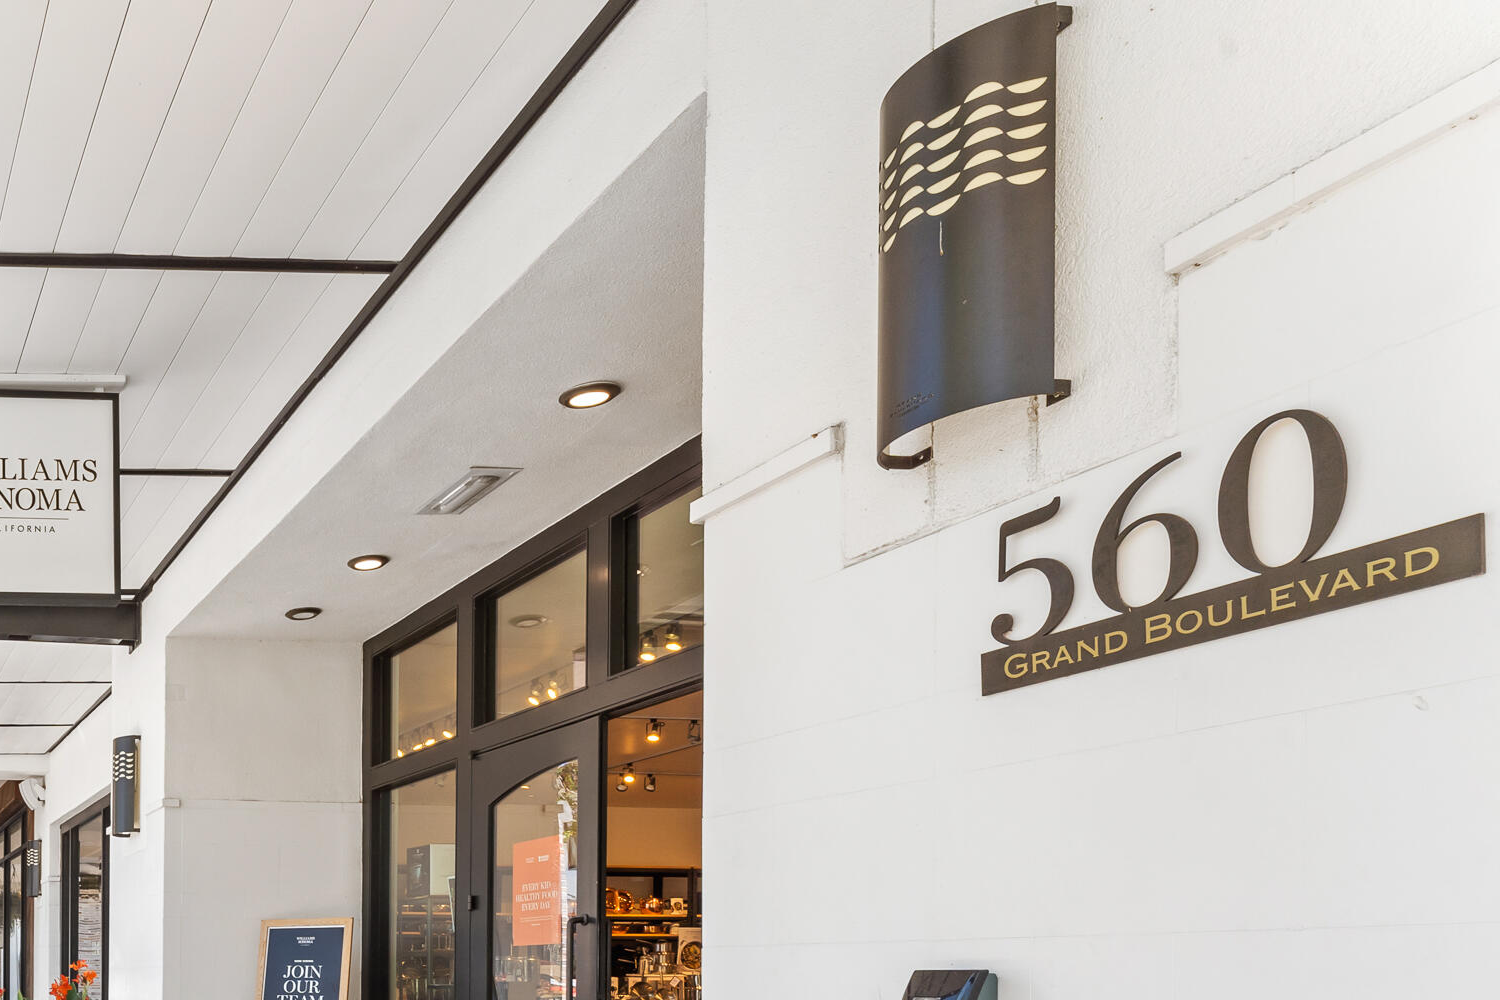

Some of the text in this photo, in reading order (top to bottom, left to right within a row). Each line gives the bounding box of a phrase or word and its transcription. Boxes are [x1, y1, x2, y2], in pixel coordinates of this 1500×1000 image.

[991, 408, 1348, 646] 560
[1003, 546, 1440, 680] GRAND BOULEVARD
[516, 892, 540, 902] HEALTHY
[522, 903, 539, 912] EVERY
[283, 965, 323, 979] JOIN
[284, 980, 320, 993] OUR
